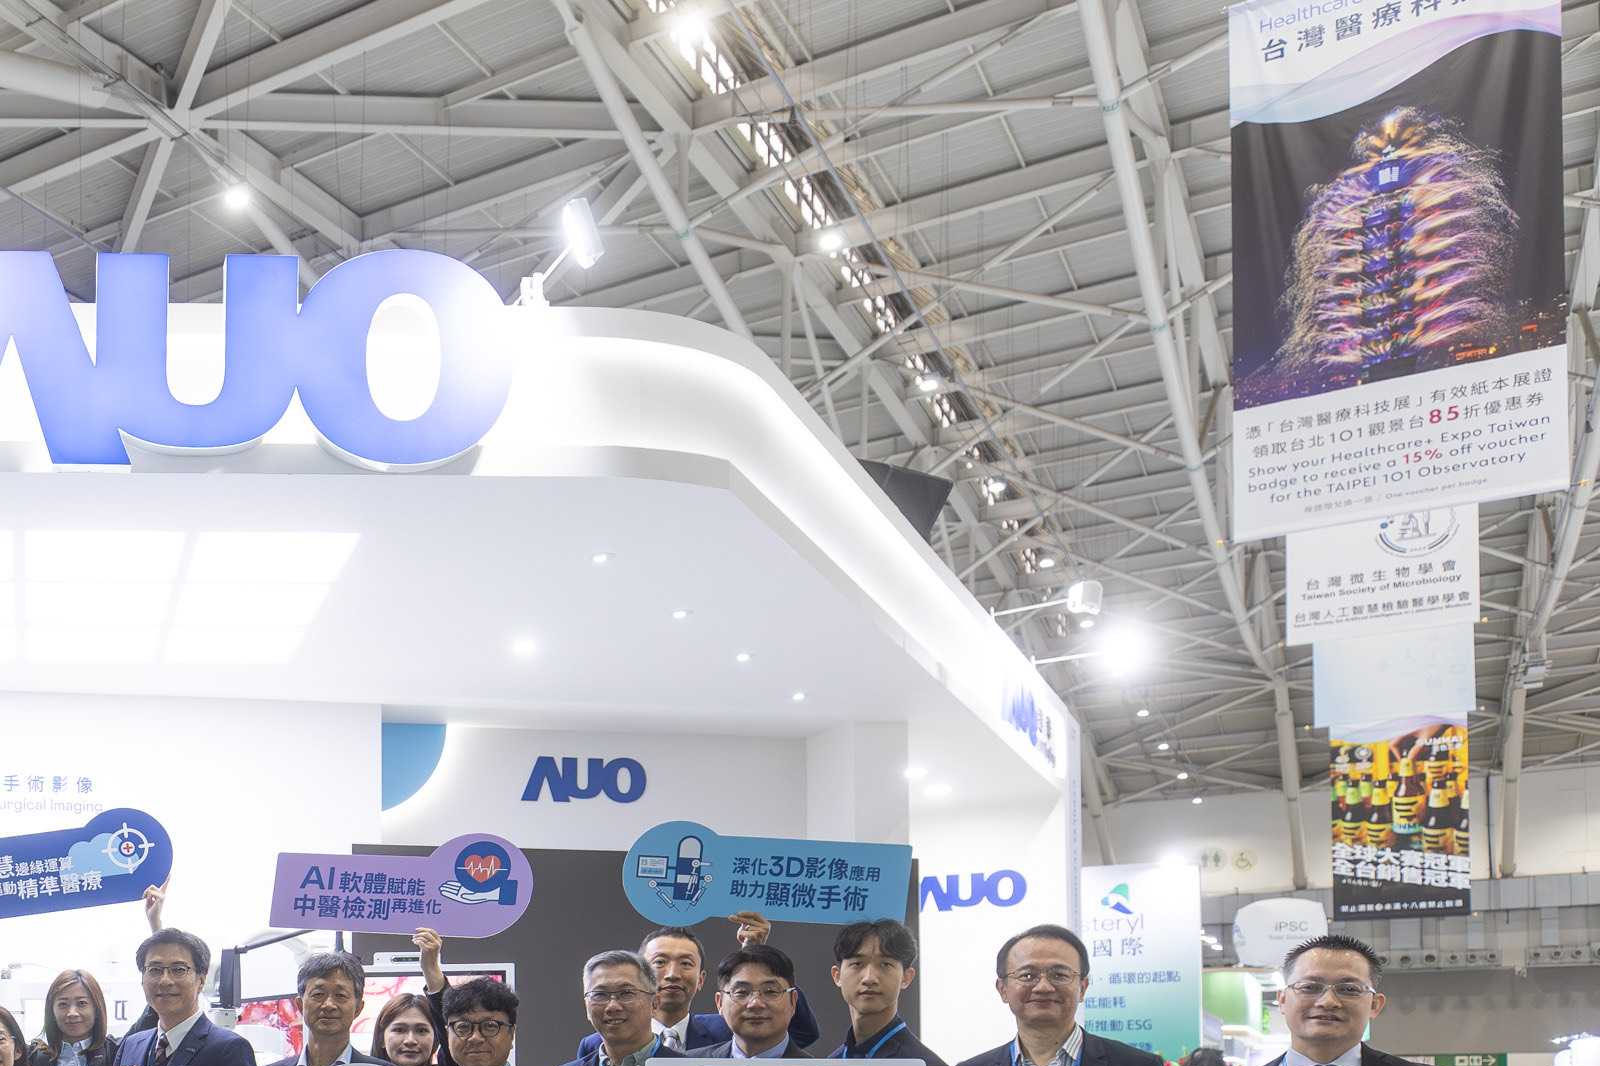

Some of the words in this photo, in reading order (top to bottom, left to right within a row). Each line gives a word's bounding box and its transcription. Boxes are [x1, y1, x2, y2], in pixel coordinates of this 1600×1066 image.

[1261, 0, 1467, 62] 台灣醫療科
[1248, 464, 1287, 478] Show
[1292, 457, 1326, 472] your
[1332, 438, 1433, 462] Healthcare+
[1441, 428, 1482, 443] Expo
[1488, 416, 1550, 434] Taiwan
[1248, 477, 1298, 493] badge
[1303, 474, 1318, 483] to
[1324, 462, 1381, 480] receive
[1402, 448, 1443, 465] 15%
[1449, 443, 1473, 457] off
[1478, 432, 1547, 451] voucher
[1270, 493, 1291, 503] for
[1297, 488, 1321, 499] the
[1327, 476, 1376, 493] TAIPEI
[1383, 470, 1412, 483] 101
[1418, 451, 1527, 478] Observatory
[1405, 486, 1438, 496] voucher
[1441, 483, 1456, 491] per
[1458, 478, 1488, 488] badge
[1301, 591, 1336, 601] Taiwan
[1339, 585, 1376, 597] Society
[1380, 583, 1390, 591] of
[1393, 574, 1462, 589] Microbiology
[521, 756, 647, 803] AUO
[50, 798, 103, 815] Imaging
[732, 854, 881, 882] 深化3D影像應用
[293, 893, 442, 921] 中醫檢測再進化
[729, 879, 869, 912] 助力顯微手術
[920, 869, 1027, 912] AUO
[1127, 1019, 1153, 1031] ESG
